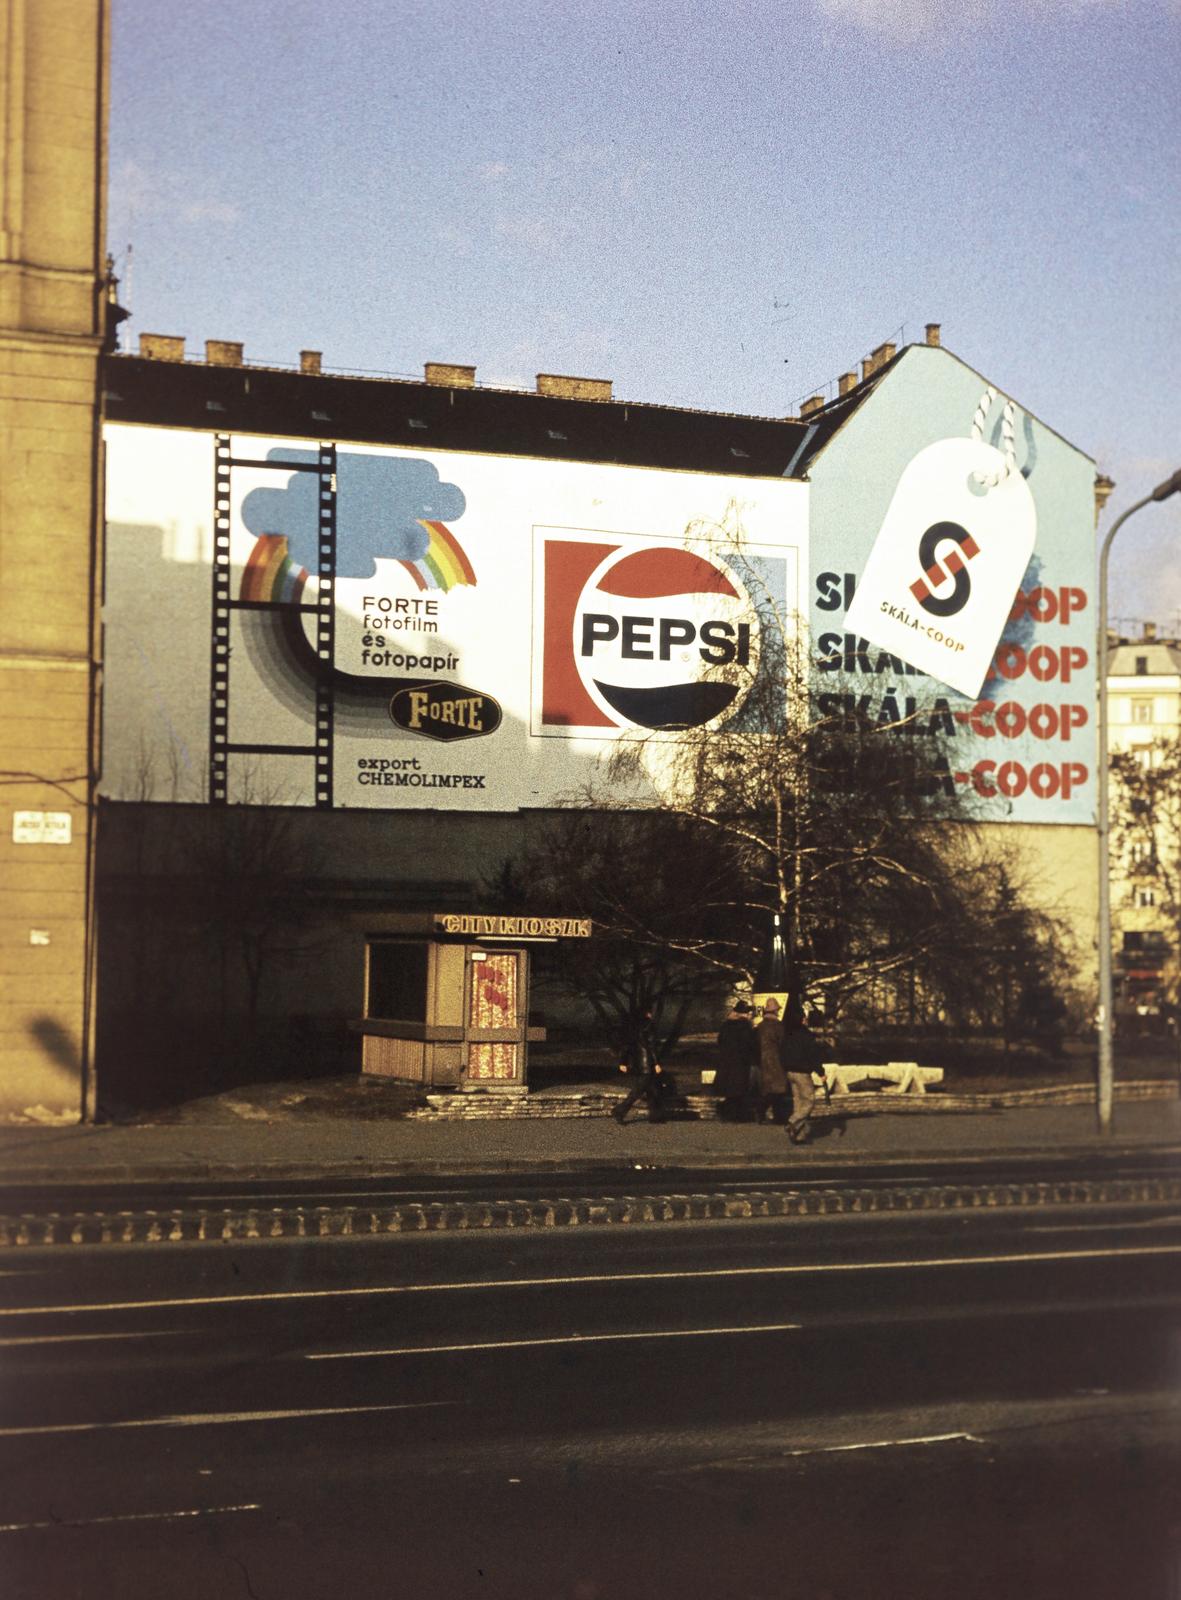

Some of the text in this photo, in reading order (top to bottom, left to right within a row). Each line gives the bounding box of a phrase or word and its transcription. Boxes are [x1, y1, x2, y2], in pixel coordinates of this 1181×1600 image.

[363, 596, 438, 615] FORTE
[363, 614, 438, 633] fotofilm
[880, 601, 965, 652] SKÁLA-COOP
[362, 630, 386, 647] és
[581, 613, 750, 666] PEPSI
[361, 650, 460, 672] fotopapír
[408, 691, 484, 731] FORTE
[357, 757, 421, 772] export
[357, 772, 486, 788] CHEMOLIMPEX
